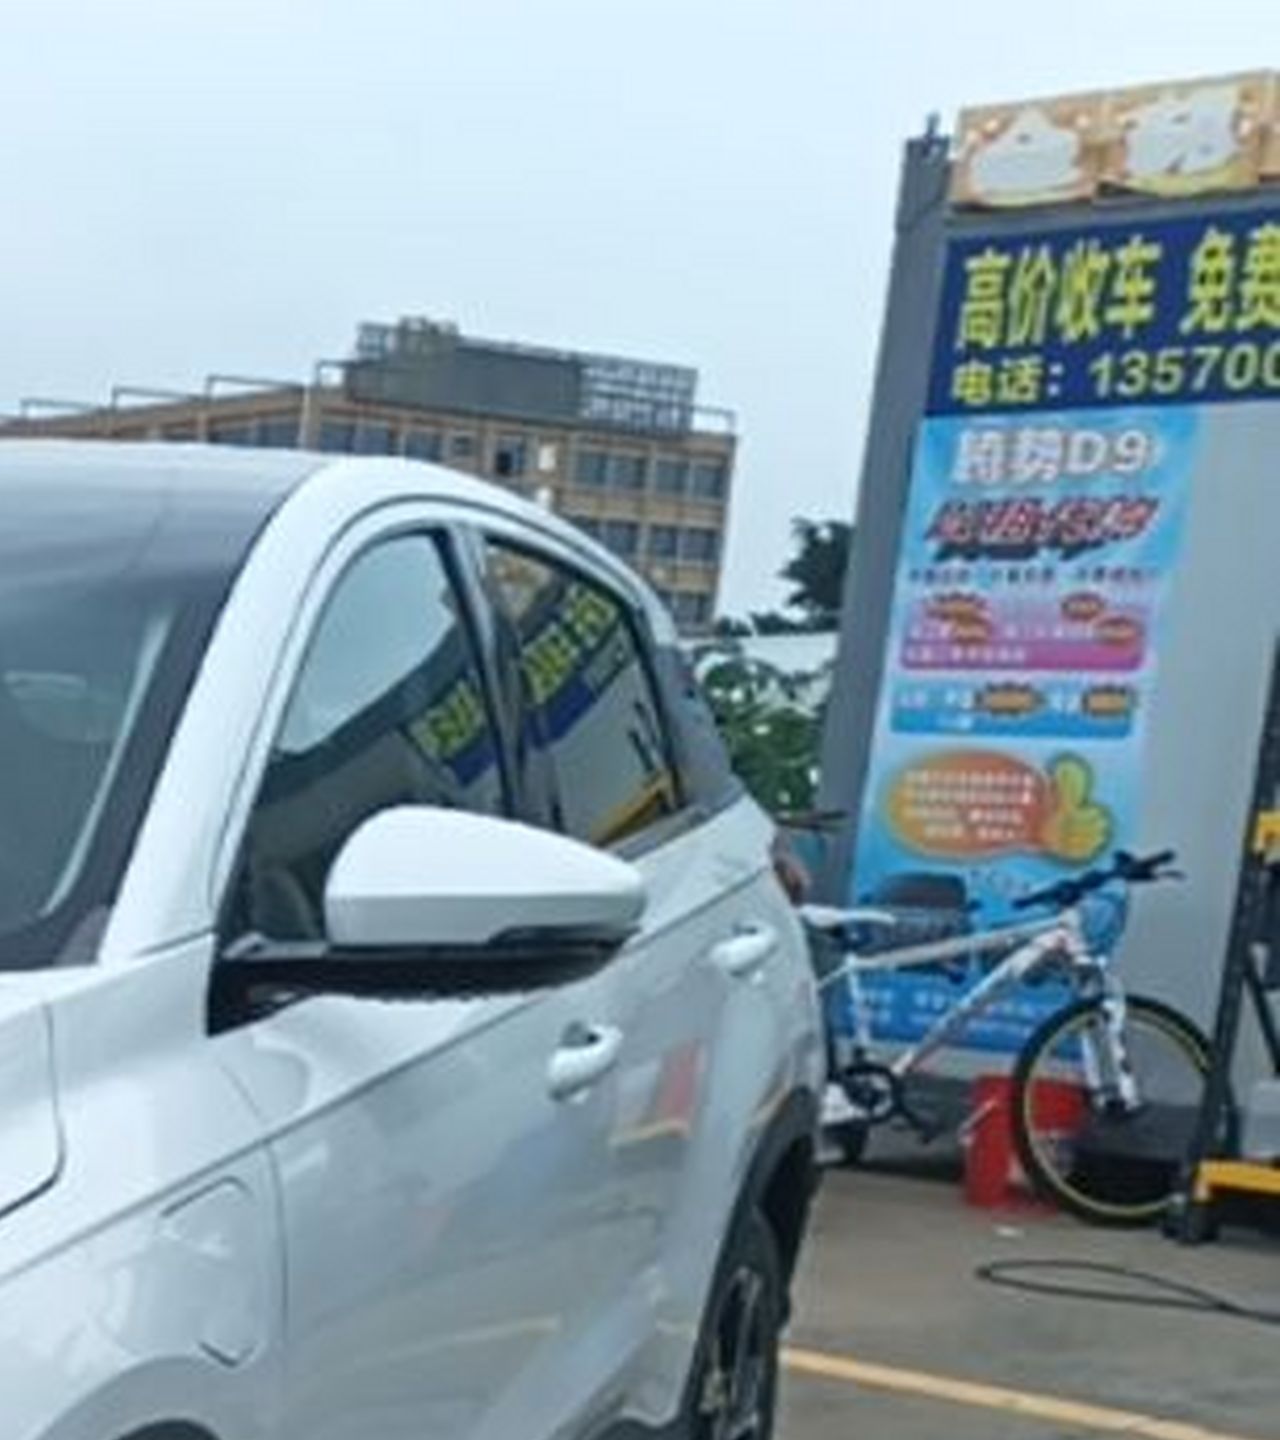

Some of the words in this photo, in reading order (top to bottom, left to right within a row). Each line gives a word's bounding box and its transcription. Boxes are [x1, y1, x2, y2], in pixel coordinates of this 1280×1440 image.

[954, 234, 1162, 351] 高价收车
[1178, 225, 1280, 332] 免费
